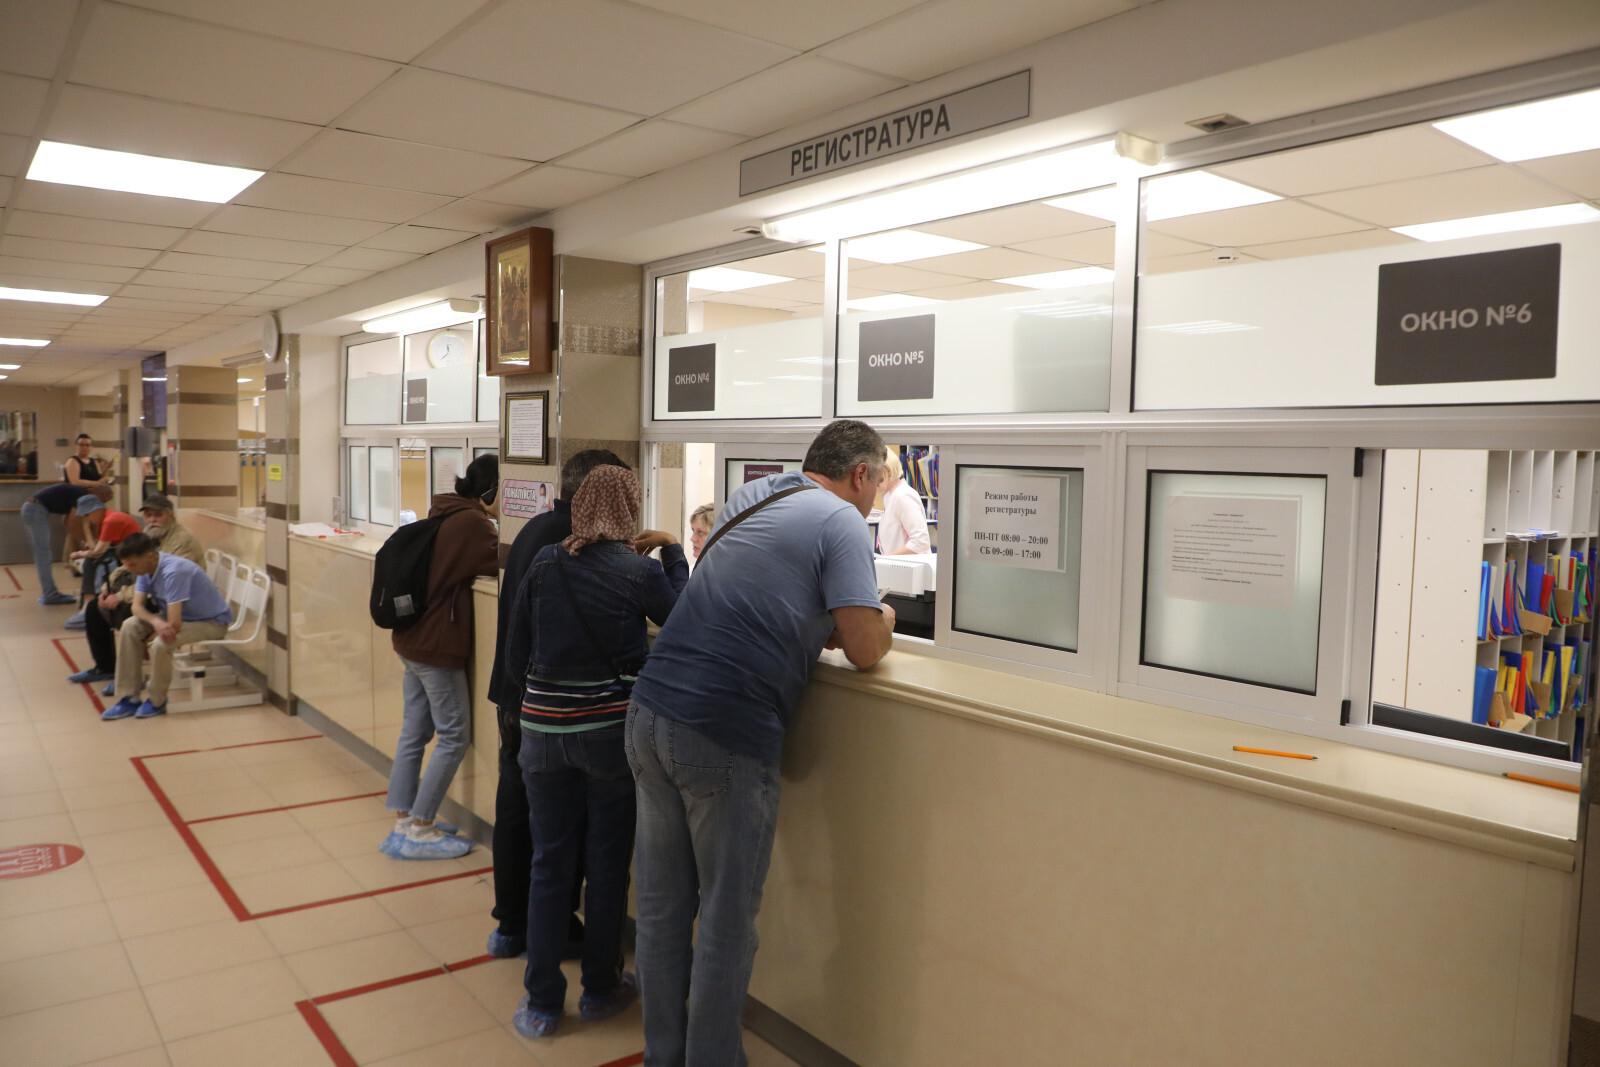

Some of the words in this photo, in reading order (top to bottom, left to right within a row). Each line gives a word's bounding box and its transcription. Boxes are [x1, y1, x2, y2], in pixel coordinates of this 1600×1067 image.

[790, 103, 951, 177] РЕГИСТРАТУРА
[1400, 308, 1479, 333] ОКНО
[1485, 303, 1533, 326] №6
[868, 353, 902, 368] ОКНО
[904, 350, 925, 365] №5
[674, 374, 696, 385] ОКНО
[697, 372, 710, 384] №4
[984, 491, 1009, 501] Режим
[1010, 492, 1038, 502] работы
[985, 506, 1036, 516] регистратуры
[974, 531, 999, 541] ПН-ПТ
[1001, 533, 1021, 543] 08:00
[1028, 535, 1049, 545] 20:00
[979, 545, 991, 555] СБ
[1021, 549, 1041, 559] 17:00
